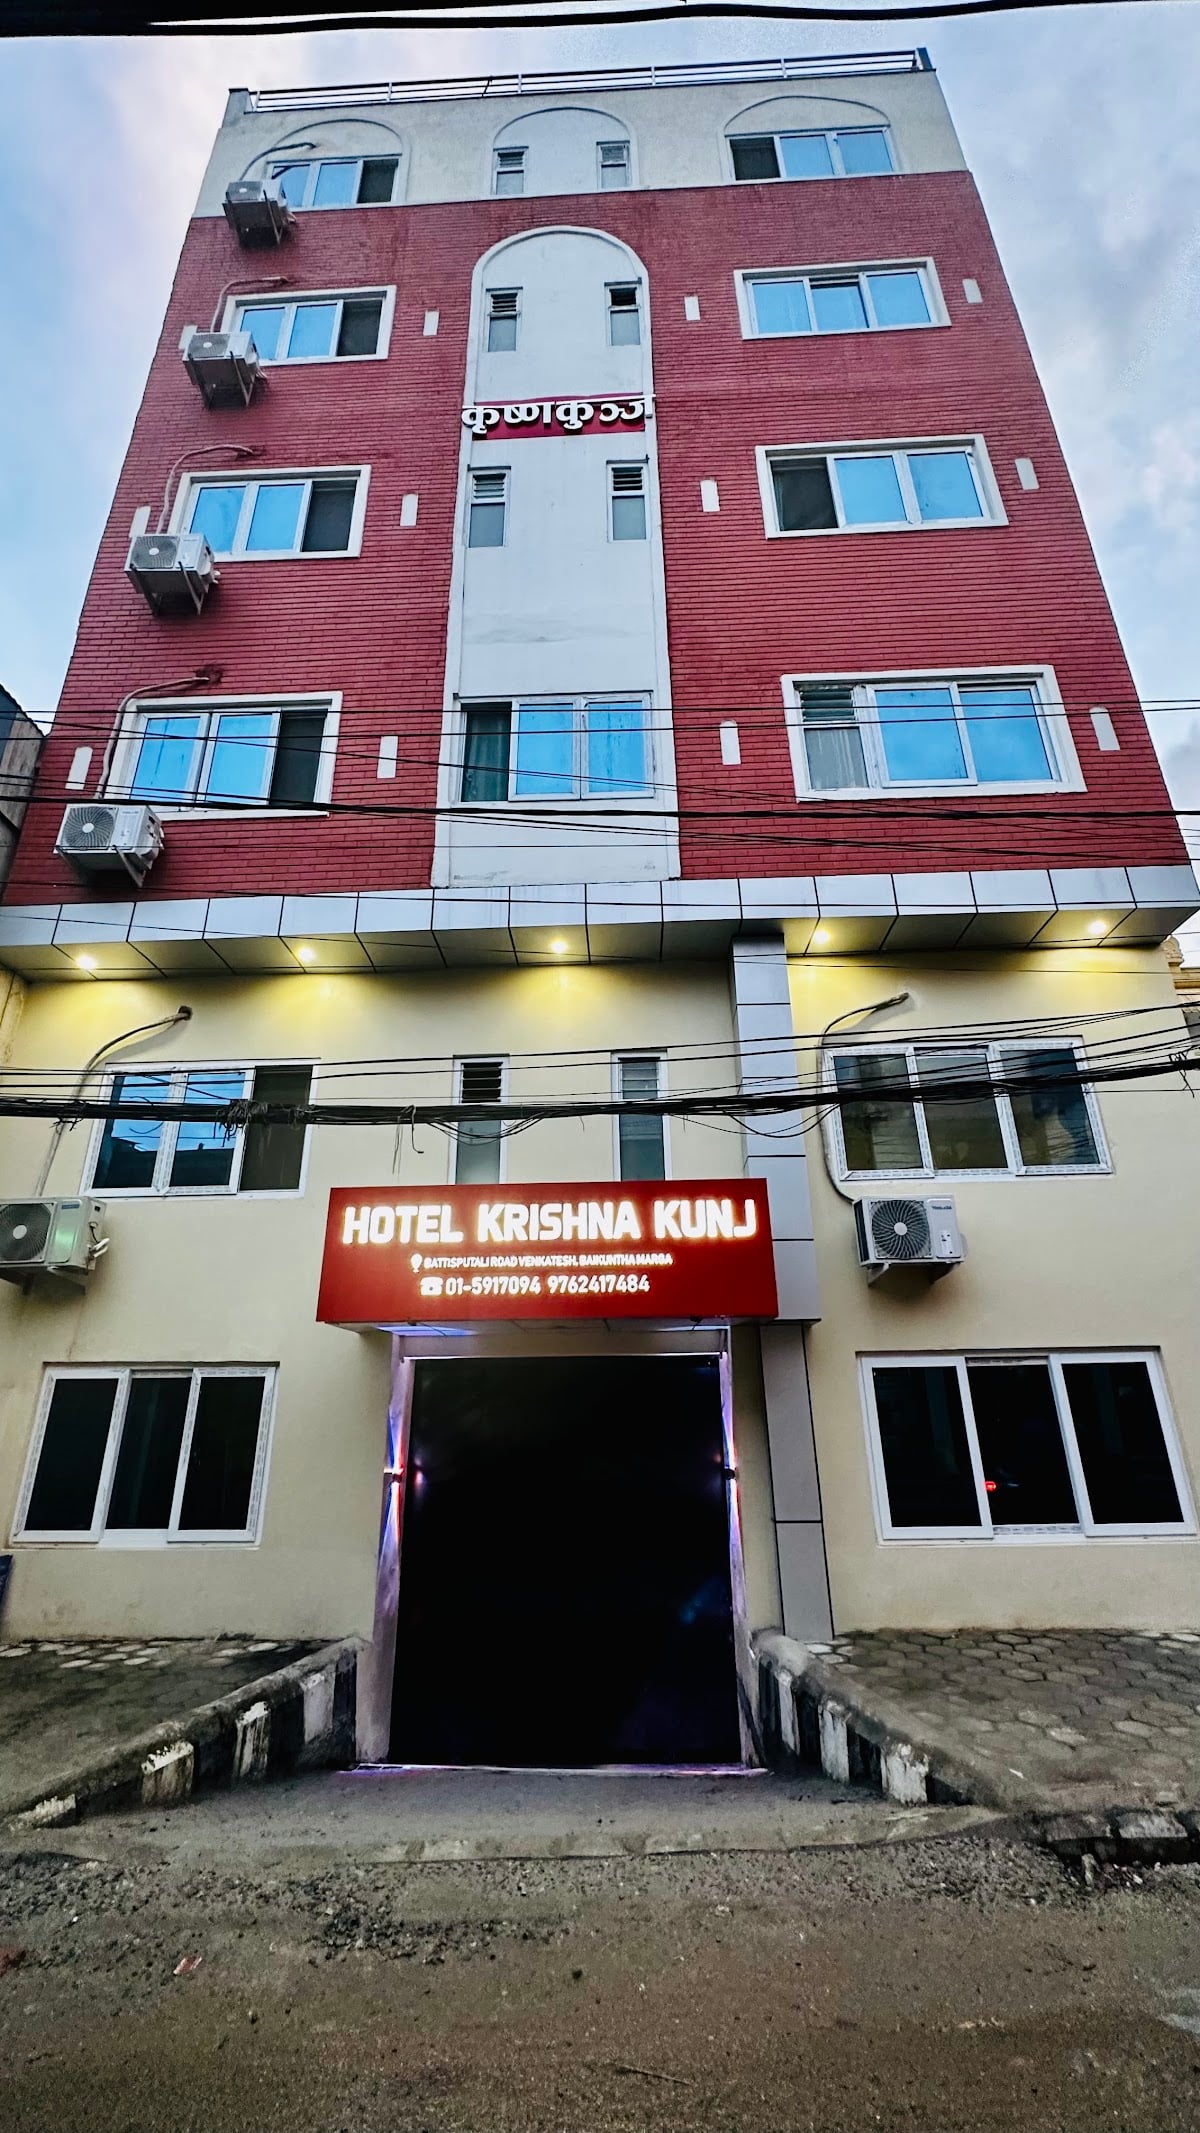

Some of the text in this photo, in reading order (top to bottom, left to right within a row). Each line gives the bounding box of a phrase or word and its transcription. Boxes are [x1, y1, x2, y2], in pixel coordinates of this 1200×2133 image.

[342, 1198, 757, 1244] HOTEL KRISHNA KUNJ
[424, 1256, 490, 1269] BATTISPUTALI
[490, 1255, 518, 1268] ROAD
[579, 1253, 635, 1267] BAIKUNTHA
[635, 1252, 674, 1266] MARGA
[445, 1274, 650, 1295] 01-5917094 9762417484
